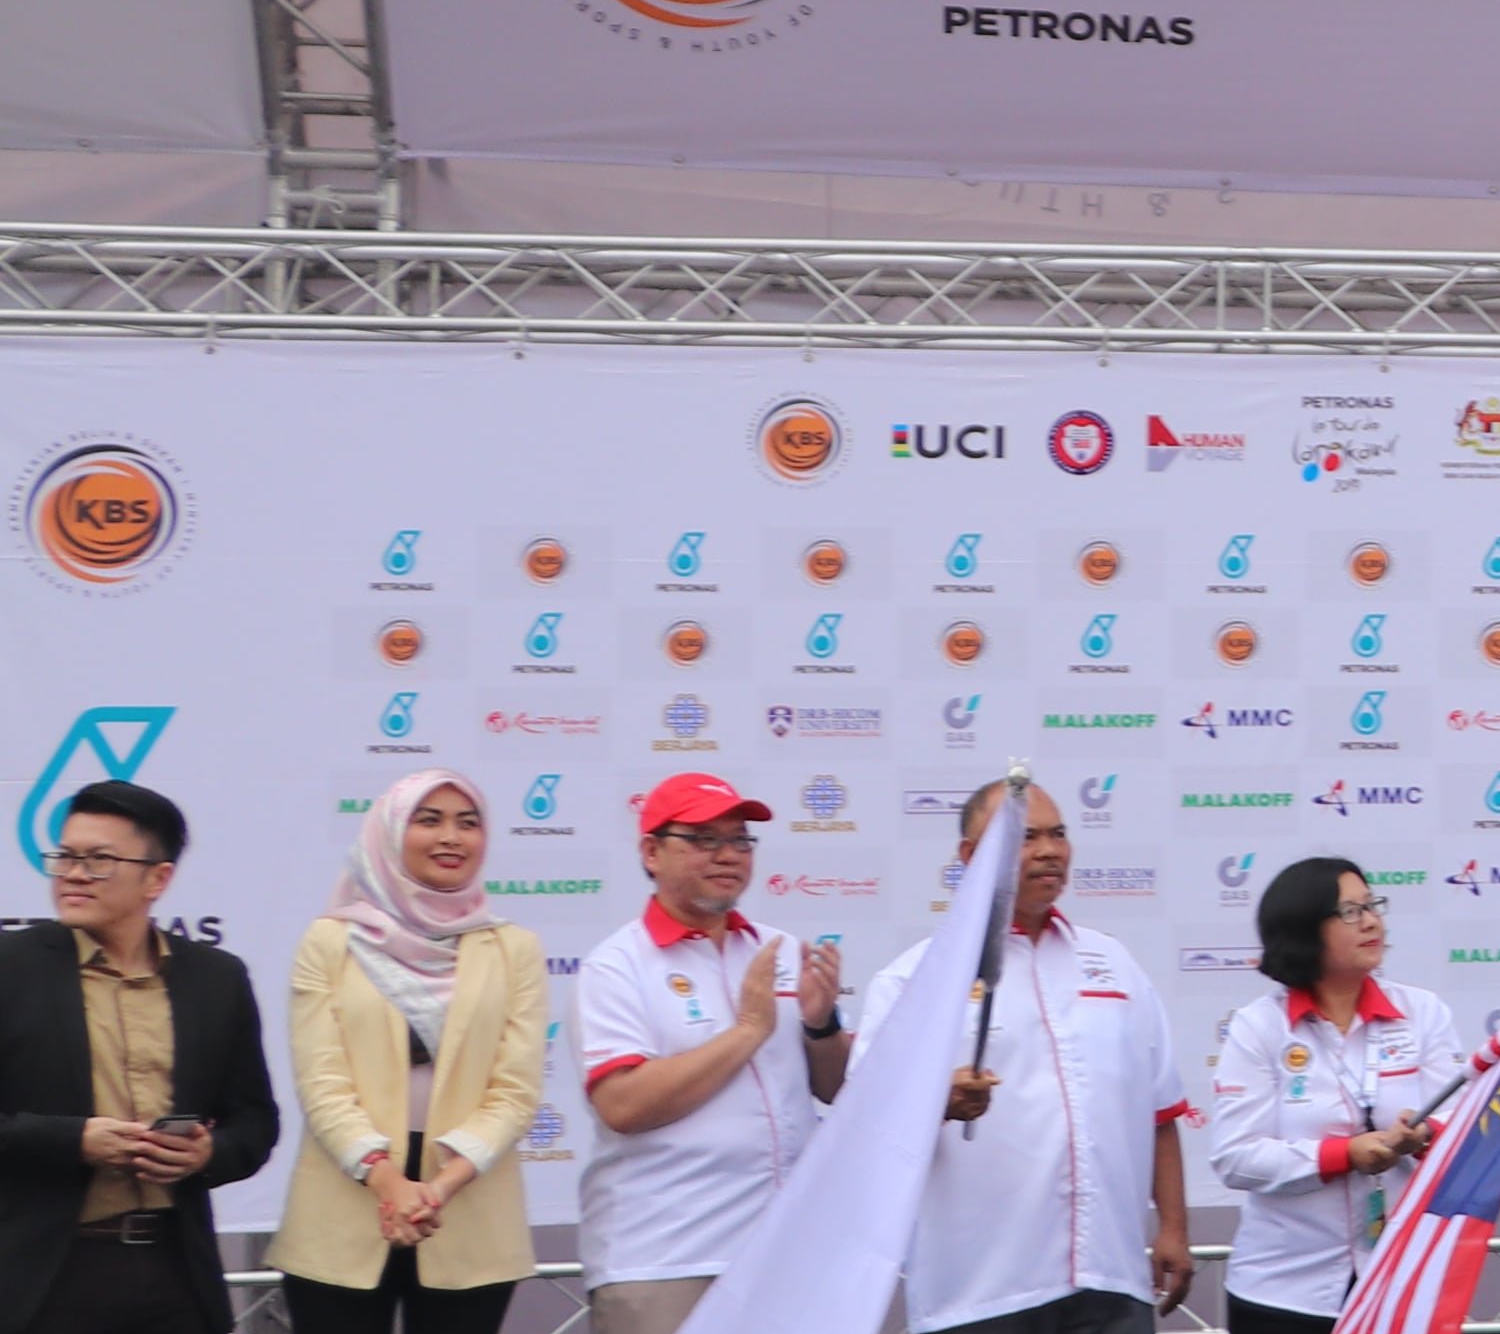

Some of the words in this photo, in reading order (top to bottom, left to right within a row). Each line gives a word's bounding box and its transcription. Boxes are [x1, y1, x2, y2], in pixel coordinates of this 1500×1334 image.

[943, 5, 1195, 46] PETRONAS
[1301, 396, 1394, 409] PETRONAS
[913, 424, 1006, 459] UCI
[74, 498, 150, 530] KBS
[1042, 713, 1157, 729] MALAKOFF
[1227, 708, 1293, 728] MMC
[1181, 792, 1294, 808] MALAKOFF
[1357, 786, 1424, 805] MMC
[1365, 871, 1427, 885] AKOFF
[485, 879, 602, 895] MALAKOFF
